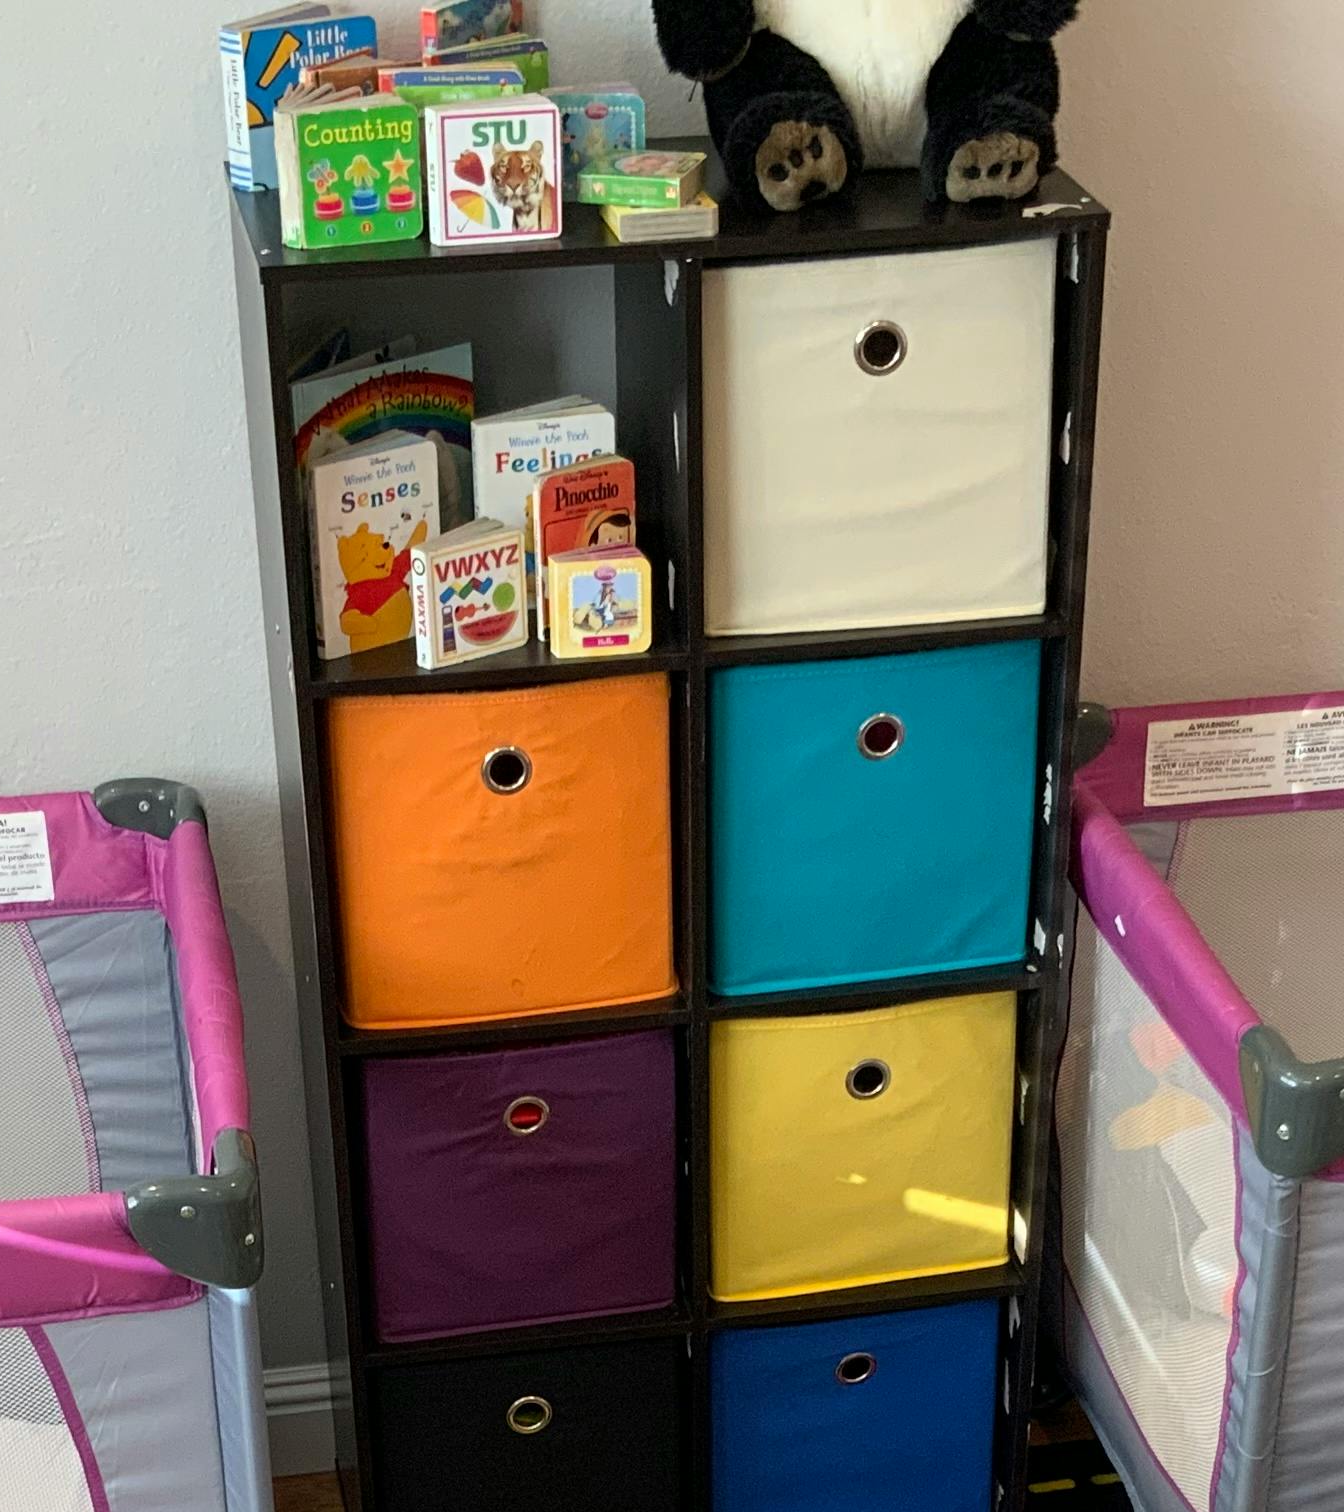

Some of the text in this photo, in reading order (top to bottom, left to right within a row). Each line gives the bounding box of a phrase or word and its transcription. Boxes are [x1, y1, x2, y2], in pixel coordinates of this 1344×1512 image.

[306, 24, 348, 47] Little
[289, 48, 330, 69] Polar
[303, 118, 413, 147] Counting
[471, 119, 527, 148] STU
[545, 433, 562, 444] the
[344, 460, 416, 487] Winnie the Pooh
[341, 481, 421, 513] Senses
[554, 482, 619, 512] Pinocchio
[434, 544, 519, 583] VWXYZ
[8, 852, 45, 862] producto
